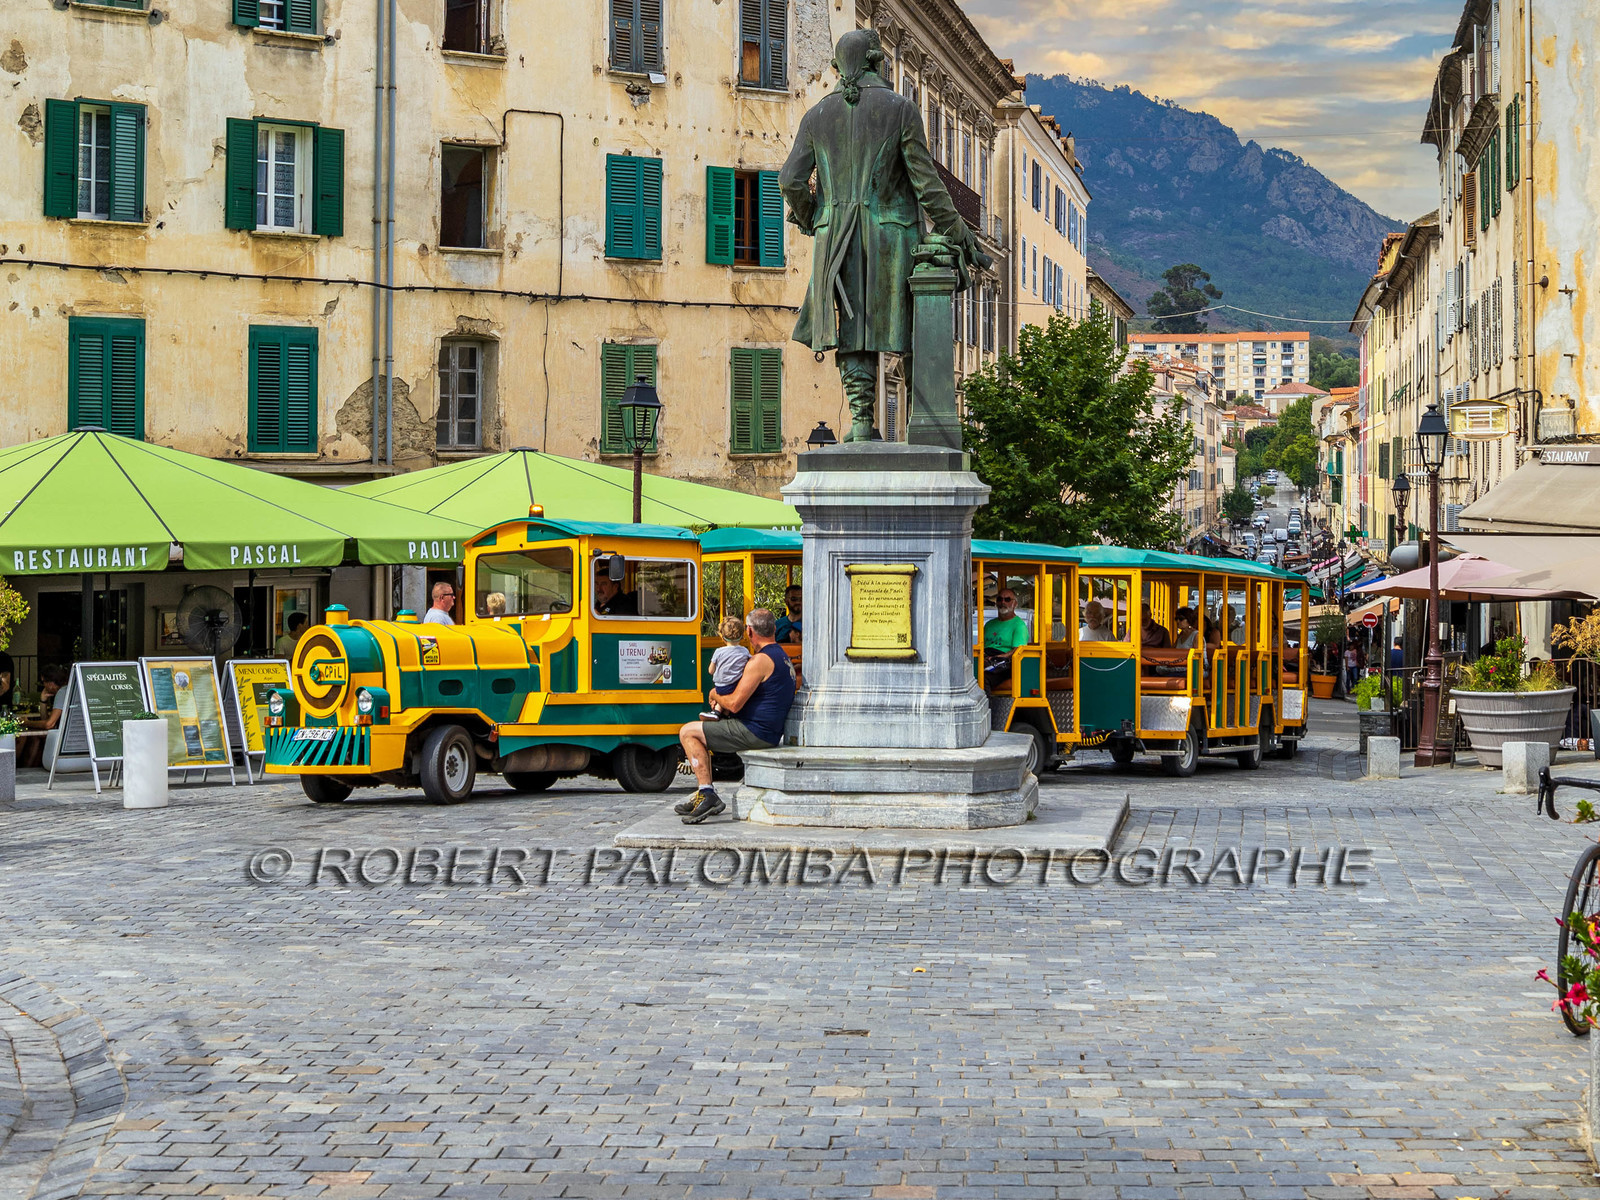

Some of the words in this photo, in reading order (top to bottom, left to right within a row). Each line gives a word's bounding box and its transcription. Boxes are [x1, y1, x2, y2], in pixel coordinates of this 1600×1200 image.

[13, 546, 149, 571] RESTAURANT
[230, 544, 302, 565] PASCAL
[408, 540, 458, 560] PAOLI
[620, 648, 625, 656] U
[626, 648, 647, 656] TRENU
[86, 672, 127, 681] SPÉCIALITÉS
